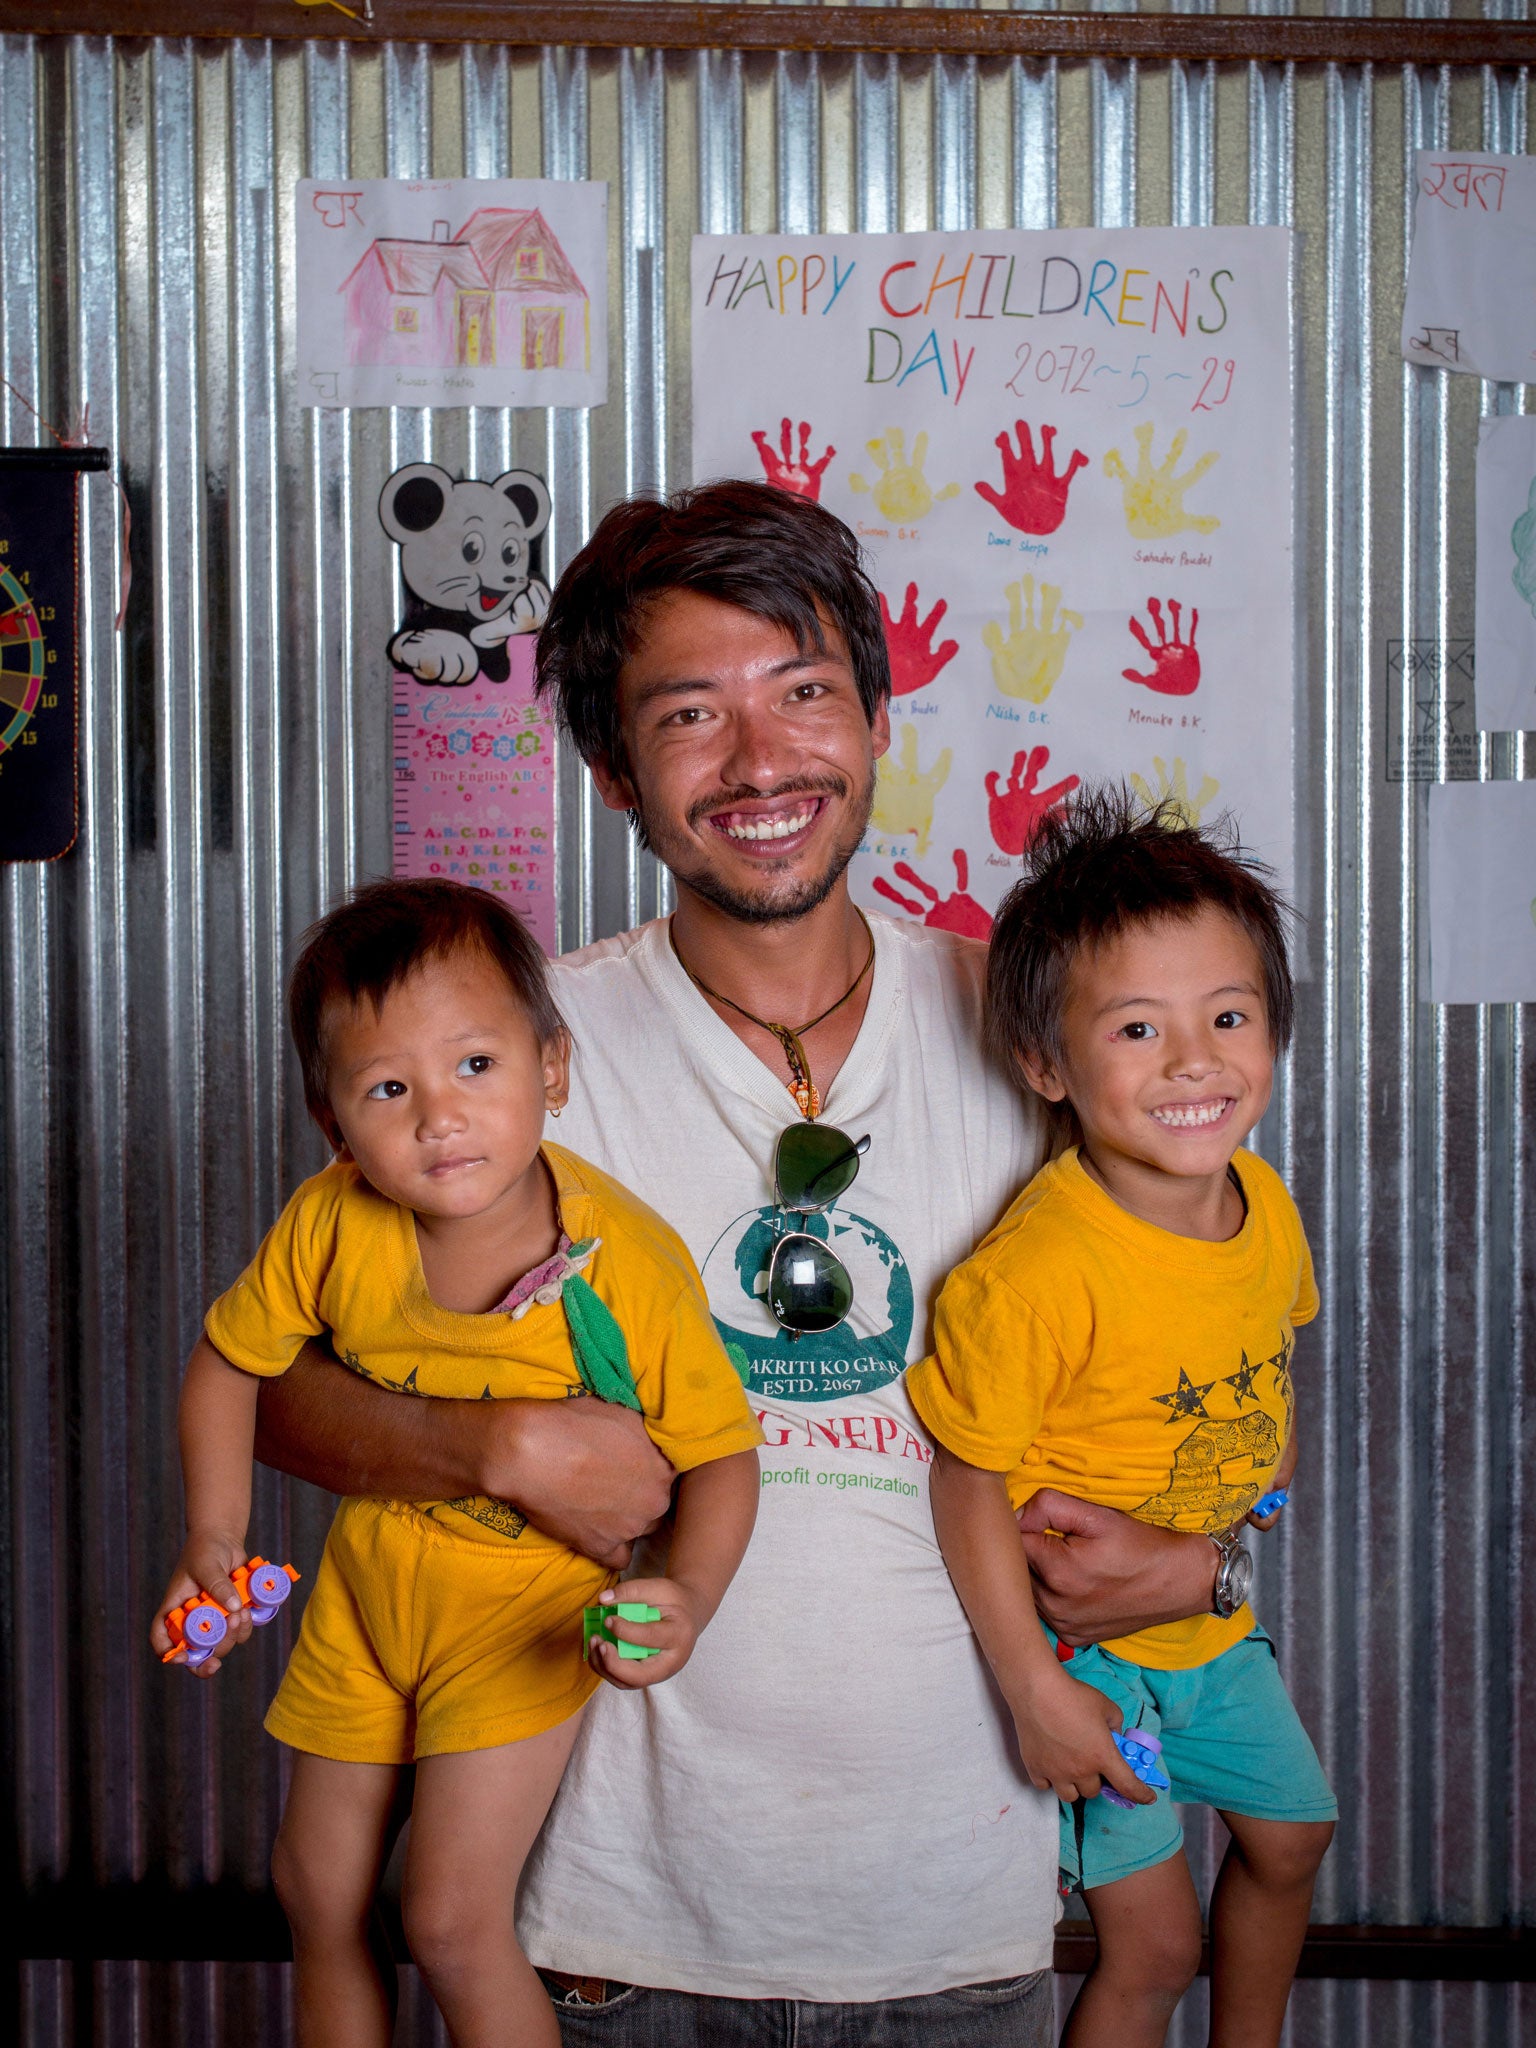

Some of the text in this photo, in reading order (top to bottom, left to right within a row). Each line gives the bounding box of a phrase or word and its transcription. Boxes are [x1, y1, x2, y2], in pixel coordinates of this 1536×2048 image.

[705, 253, 1234, 338] HAPPY CHILDREN'S
[865, 327, 975, 406] DAY
[20, 571, 30, 585] 4
[39, 607, 55, 620] 13
[47, 650, 57, 663] 6
[42, 695, 58, 708] 10
[502, 705, 542, 726] 公主
[22, 732, 37, 745] 15
[431, 770, 544, 783] The English ABC
[748, 1359, 816, 1375] AKRITI
[820, 1359, 850, 1375] KO
[763, 1379, 861, 1396] ESTD. 2067
[816, 1472, 919, 1498] organization
